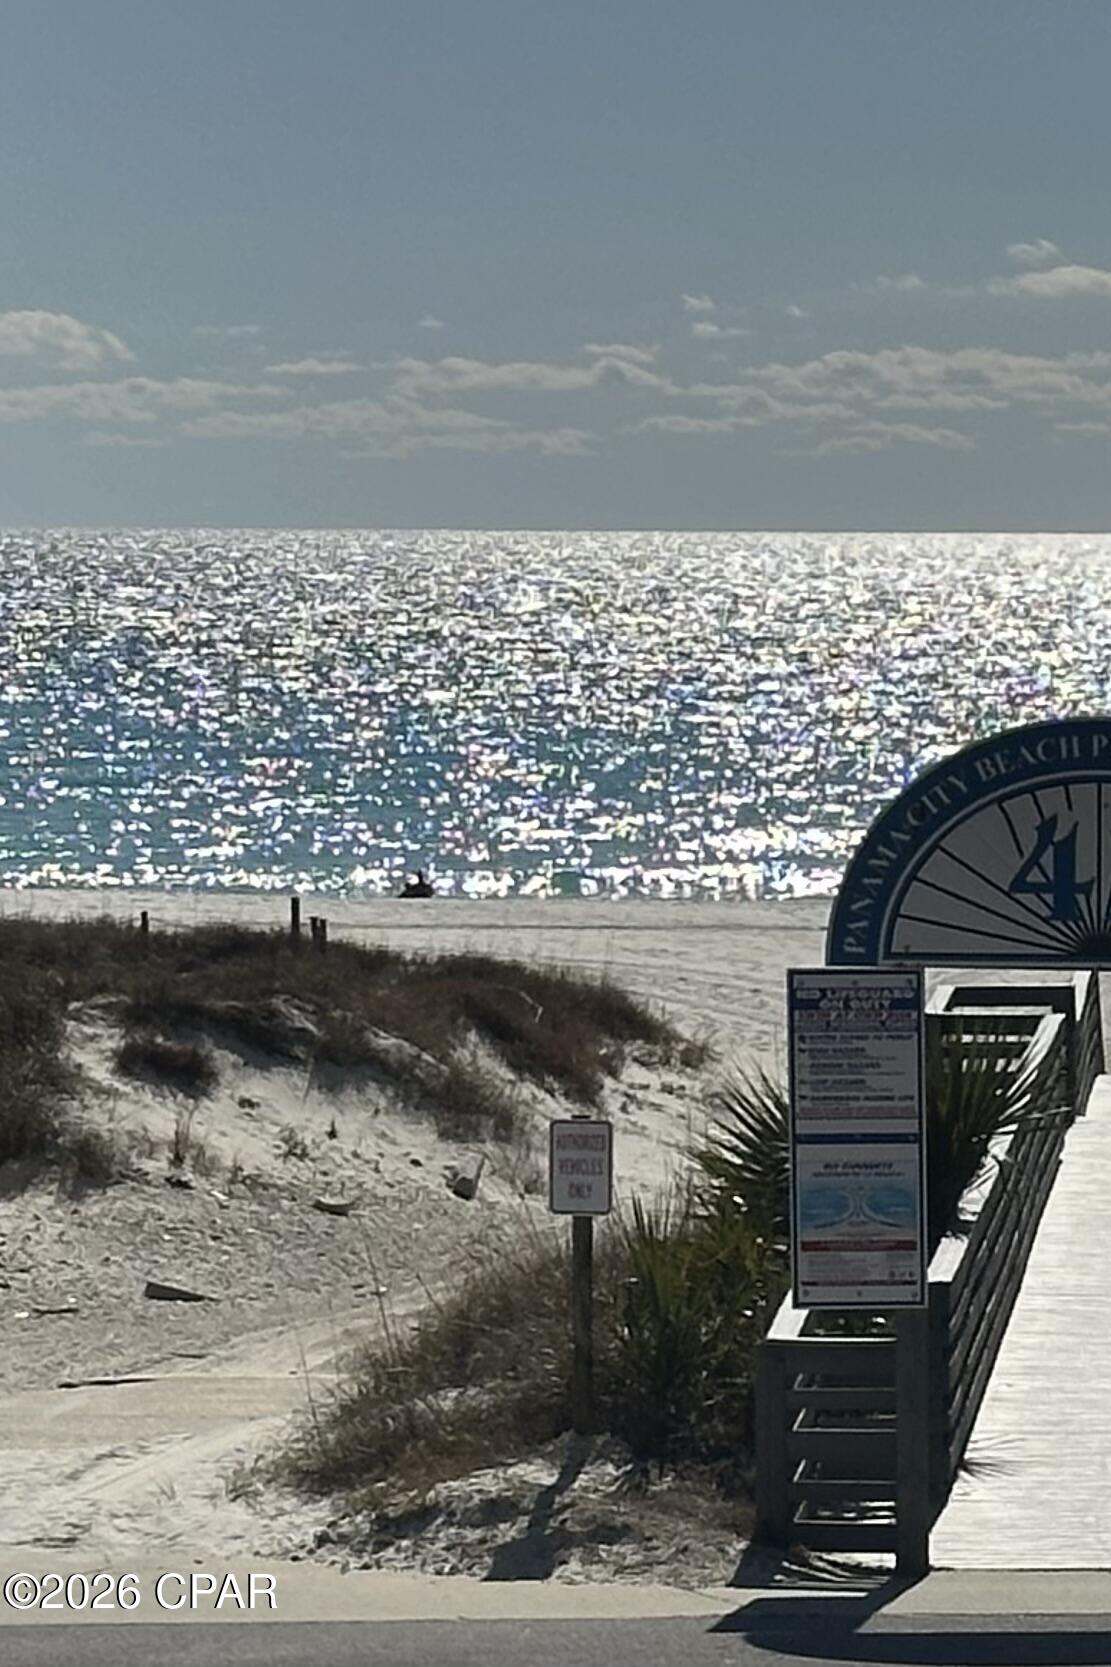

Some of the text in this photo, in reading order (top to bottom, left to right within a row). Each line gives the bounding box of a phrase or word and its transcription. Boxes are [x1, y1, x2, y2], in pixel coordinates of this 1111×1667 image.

[843, 829, 911, 953] PANAMA
[906, 774, 968, 827] CITY
[974, 735, 1080, 781] BEACH
